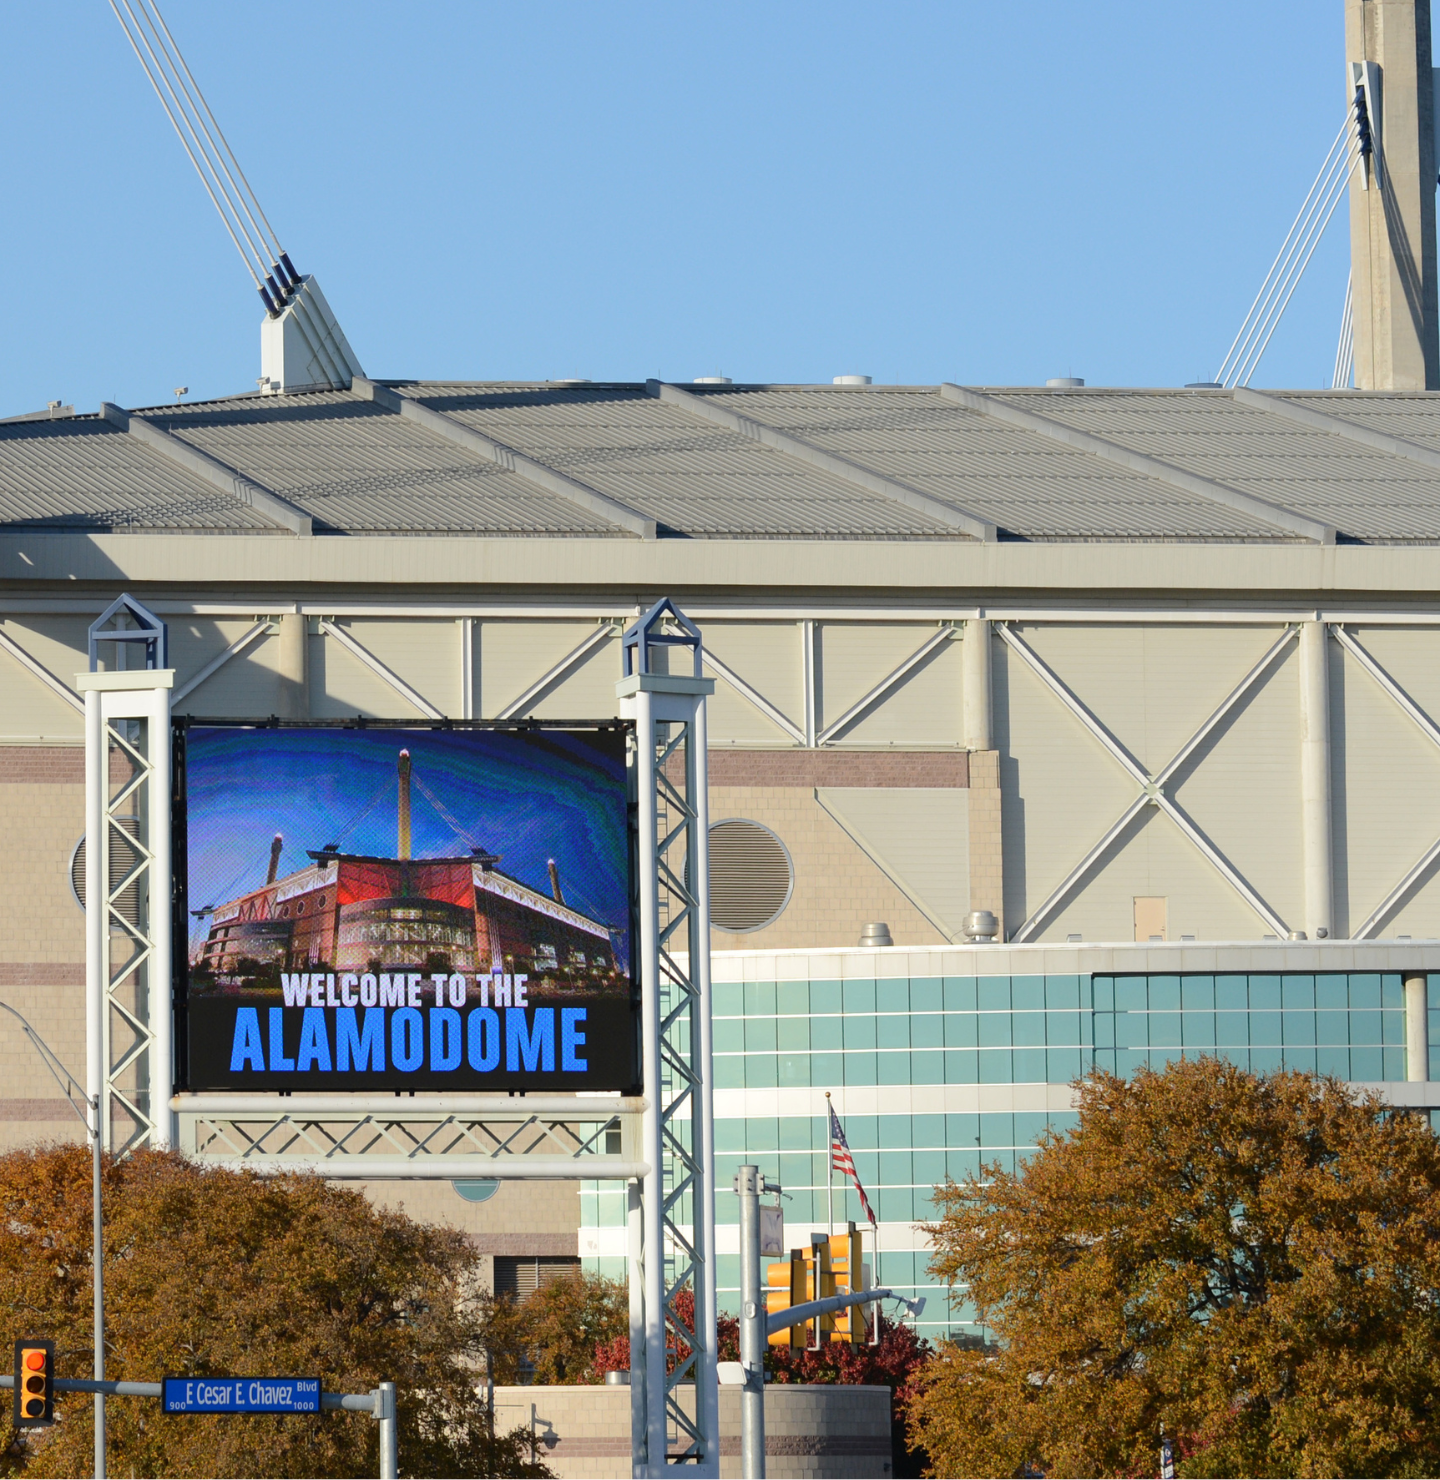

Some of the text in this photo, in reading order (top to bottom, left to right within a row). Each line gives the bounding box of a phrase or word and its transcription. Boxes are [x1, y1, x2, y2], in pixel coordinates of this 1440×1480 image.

[281, 973, 528, 1007] WELCOME TO THE
[229, 1007, 588, 1073] ALAMODOME
[186, 1381, 317, 1405] E Cesar E. Chavez Blvd
[169, 1401, 186, 1410] 900
[293, 1401, 314, 1410] 1000
